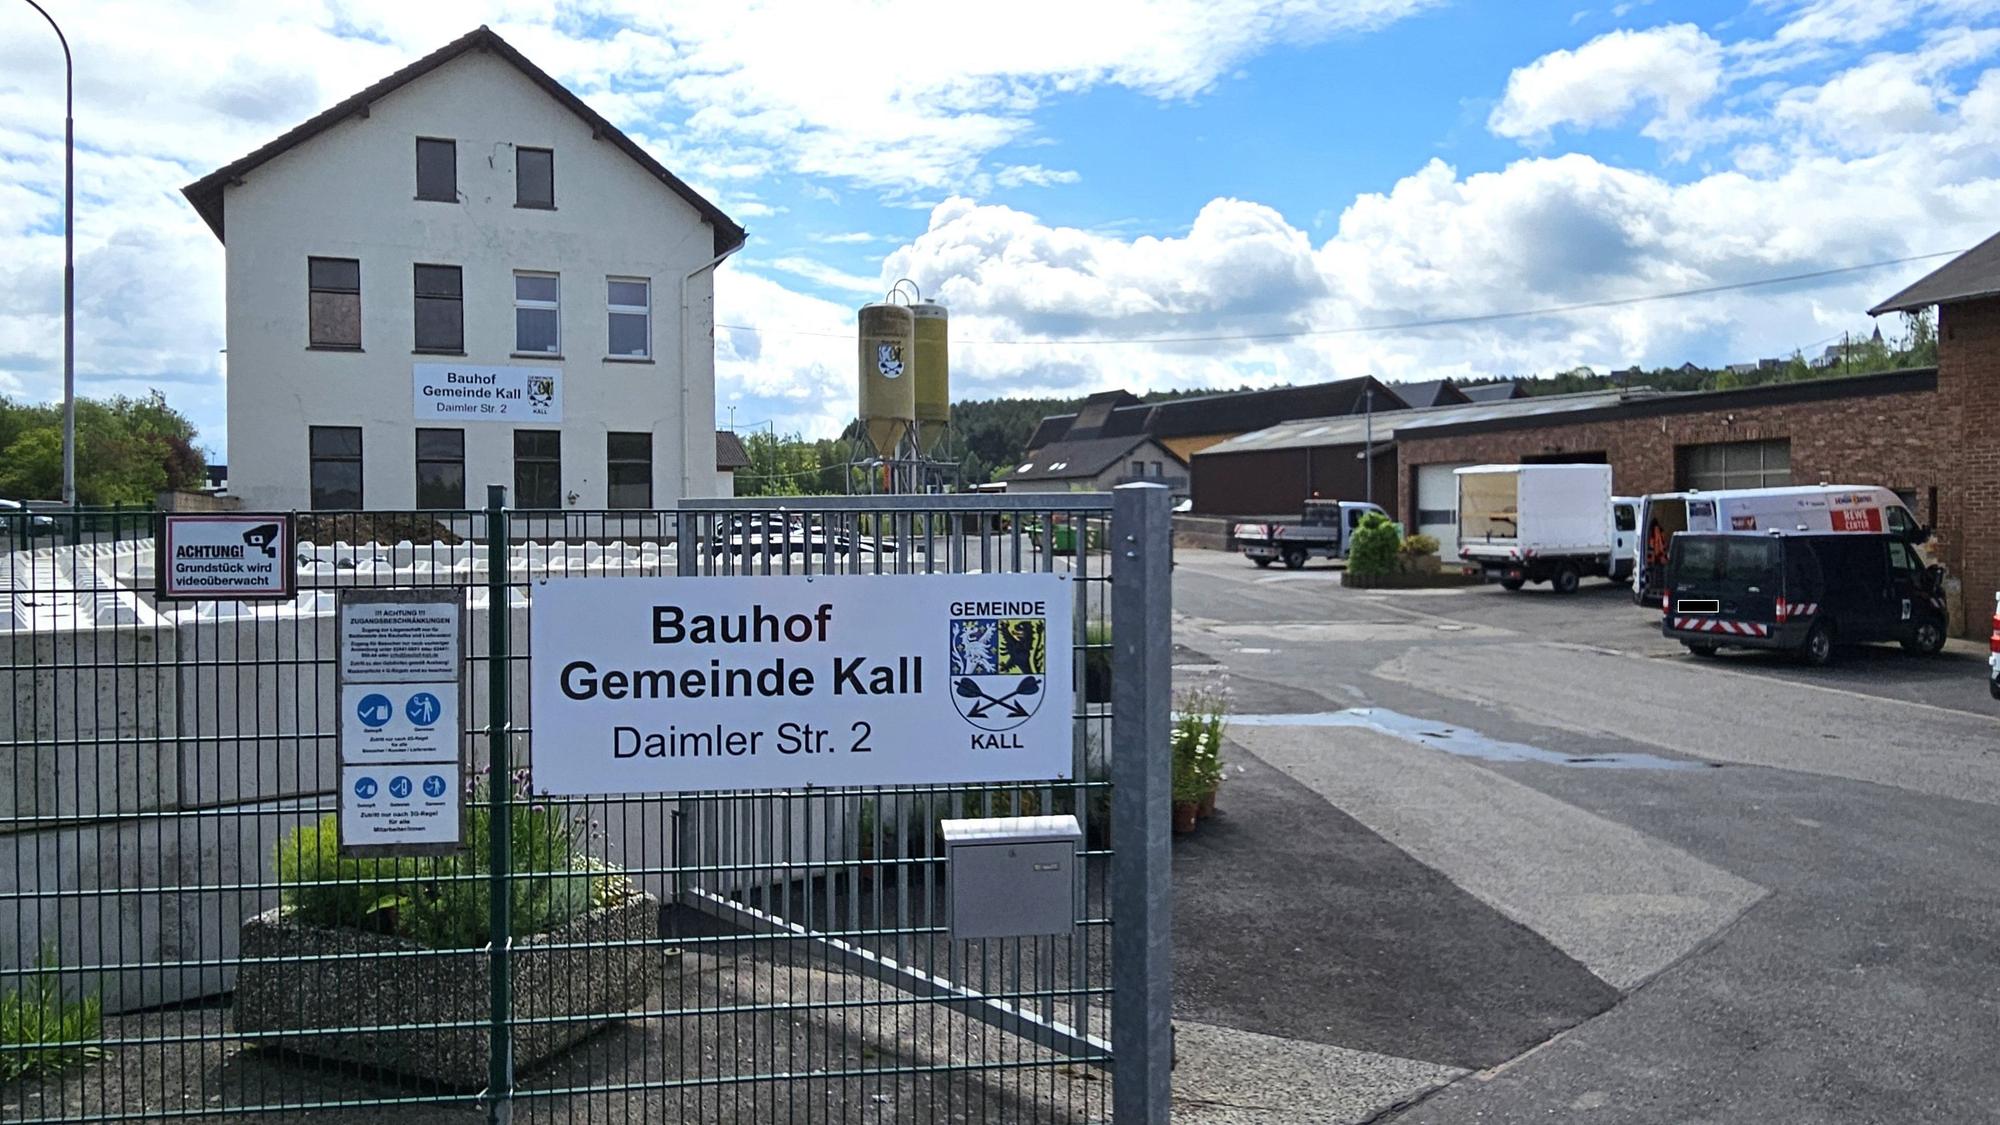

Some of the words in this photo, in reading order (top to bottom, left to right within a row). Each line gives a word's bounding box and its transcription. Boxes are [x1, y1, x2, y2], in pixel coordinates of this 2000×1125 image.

[447, 372, 497, 385] Bauhof
[422, 385, 492, 399] Gemeinde
[495, 387, 521, 400] Kall
[436, 402, 477, 413] Daimler
[480, 403, 498, 414] Str.
[500, 404, 507, 414] 2
[176, 545, 244, 558] ACHTUNG!
[175, 563, 244, 573] Grundstück
[246, 562, 272, 573] wird
[175, 575, 269, 587] videoüberwacht
[949, 600, 1046, 617] GEMEINDE
[652, 603, 833, 645] Bauhof
[560, 657, 815, 701] Gemeinde
[833, 655, 922, 696] Kall
[613, 724, 764, 759] Daimler
[776, 722, 835, 755] Str.
[850, 721, 872, 753] 2
[971, 733, 1025, 750] KALL
